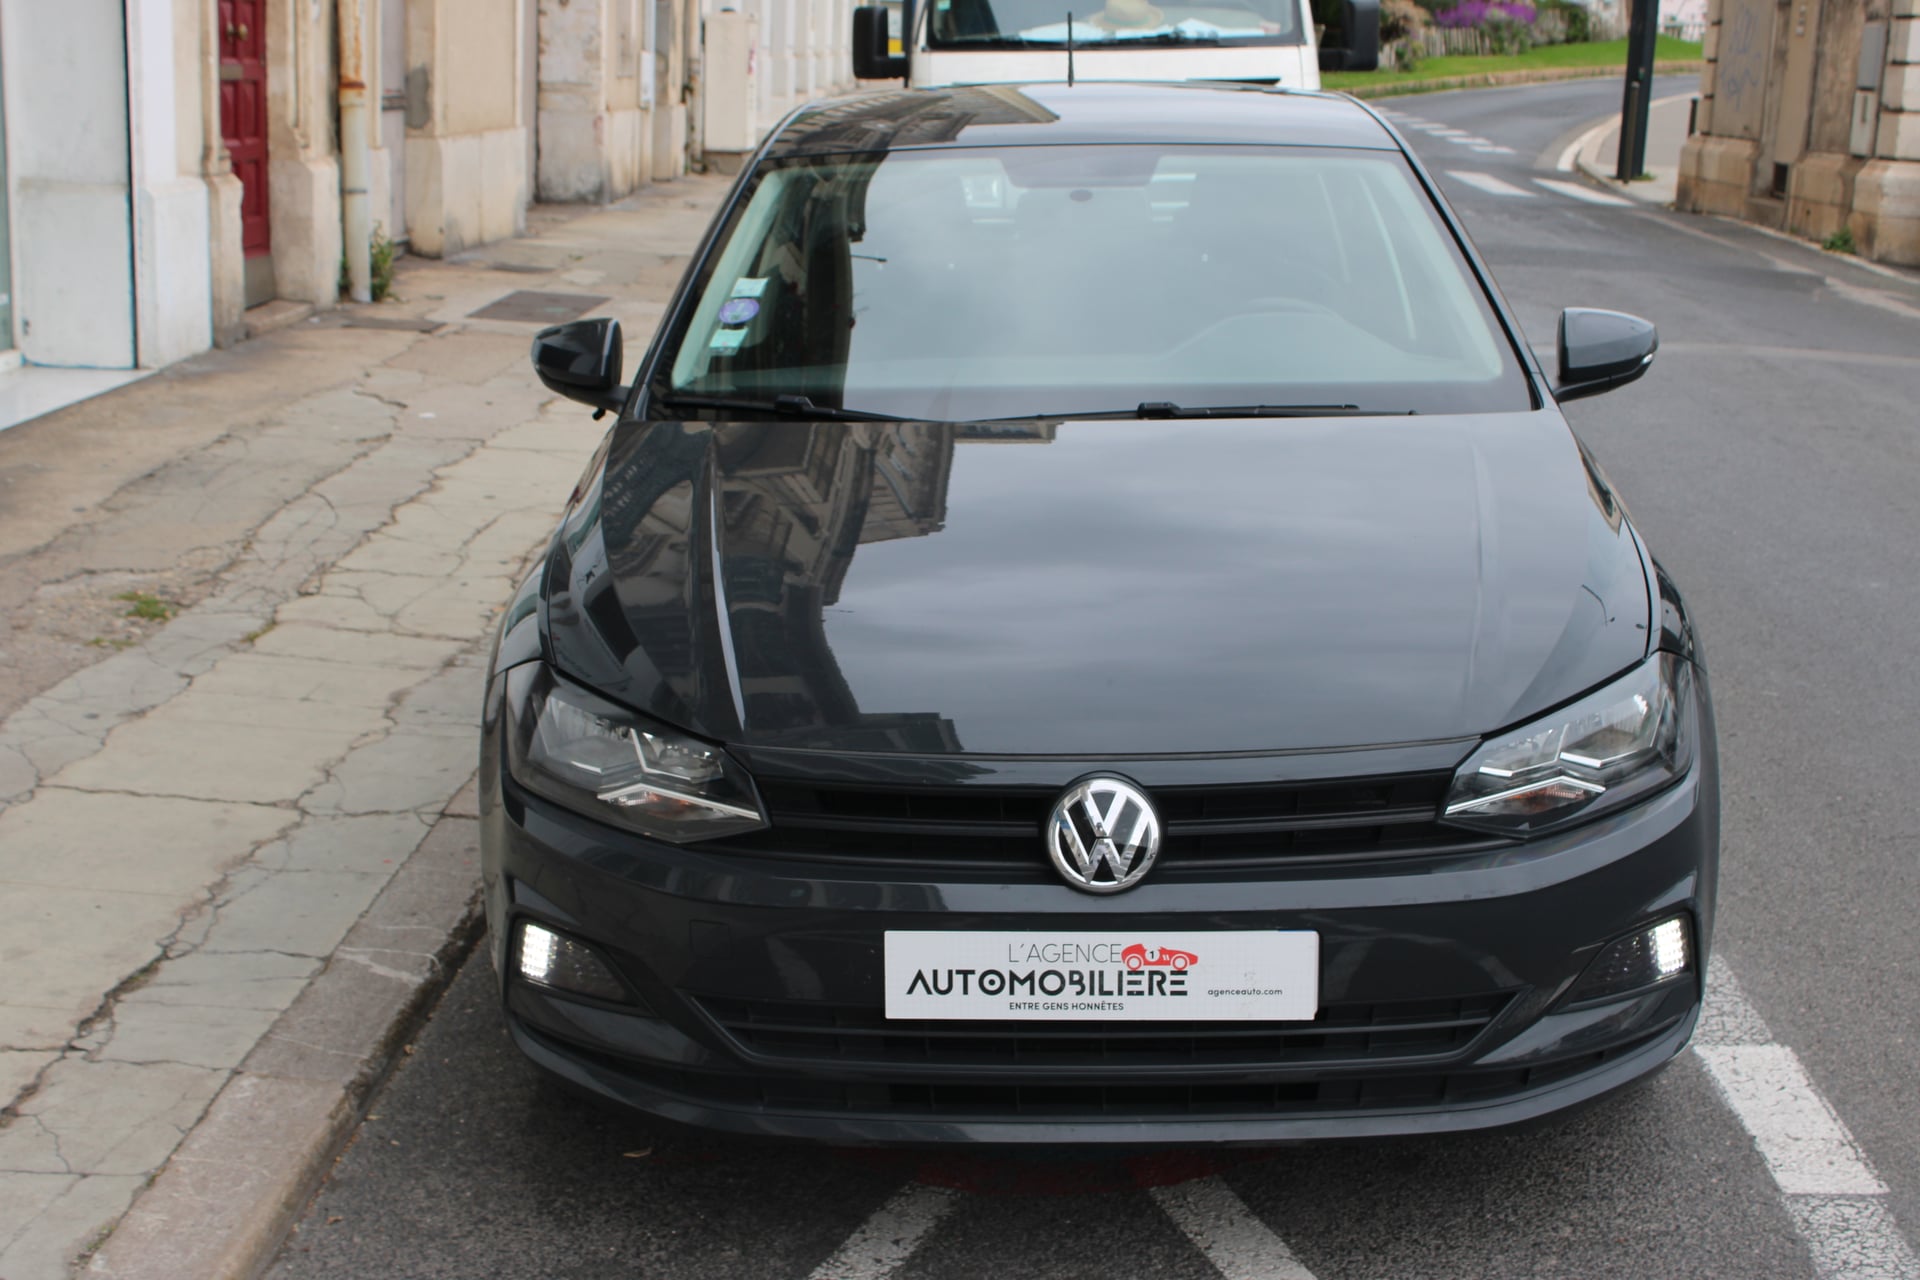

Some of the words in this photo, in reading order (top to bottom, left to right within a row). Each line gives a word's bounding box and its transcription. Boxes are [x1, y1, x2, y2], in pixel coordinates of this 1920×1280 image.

[1009, 943, 1122, 963] L'AGENCE
[1207, 988, 1283, 998] agenceauto.com
[1009, 1002, 1040, 1011] ENTRE
[1042, 1002, 1069, 1011] GENS
[1072, 1000, 1125, 1011] HONNÊTES
